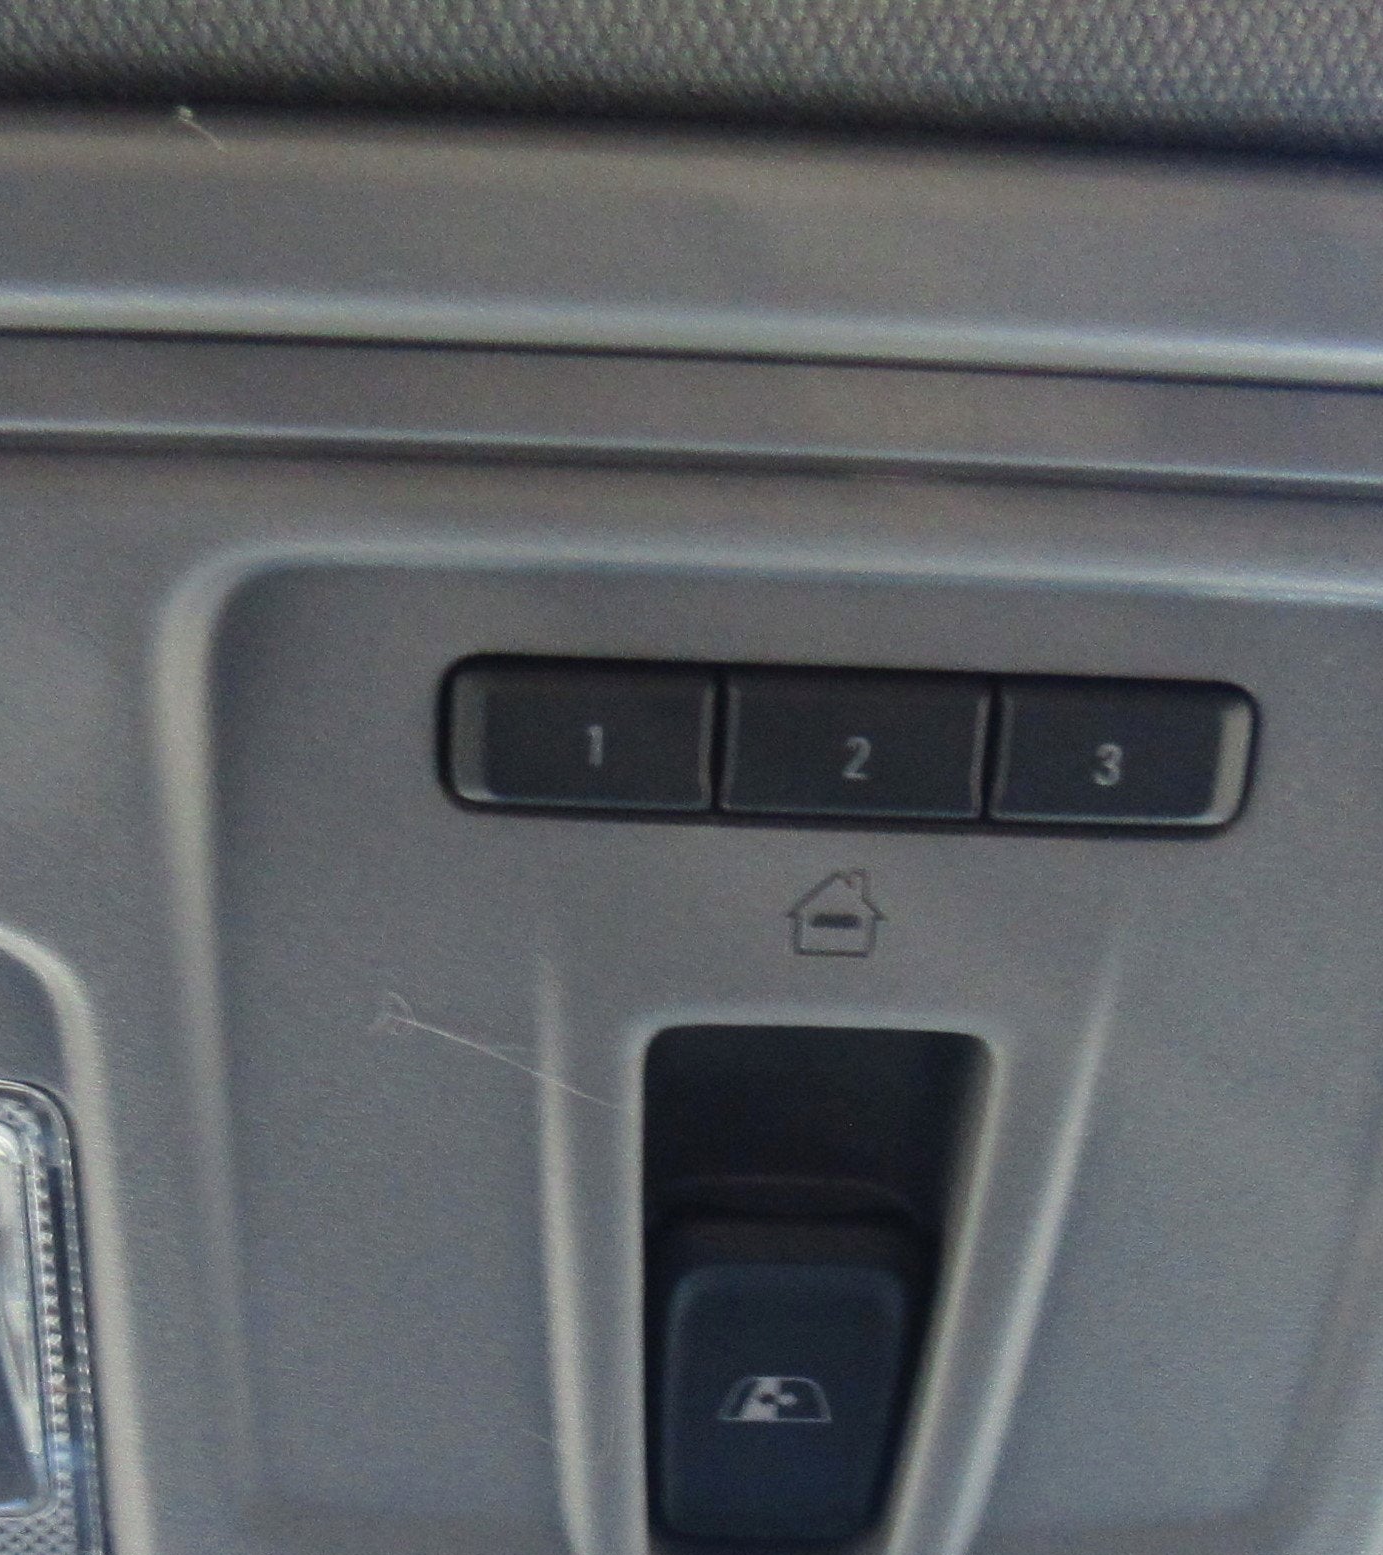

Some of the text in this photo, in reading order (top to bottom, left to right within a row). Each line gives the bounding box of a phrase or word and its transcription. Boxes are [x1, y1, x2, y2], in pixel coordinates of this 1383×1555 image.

[585, 724, 604, 767] 1
[842, 735, 873, 780] 2
[1091, 743, 1123, 787] 3
